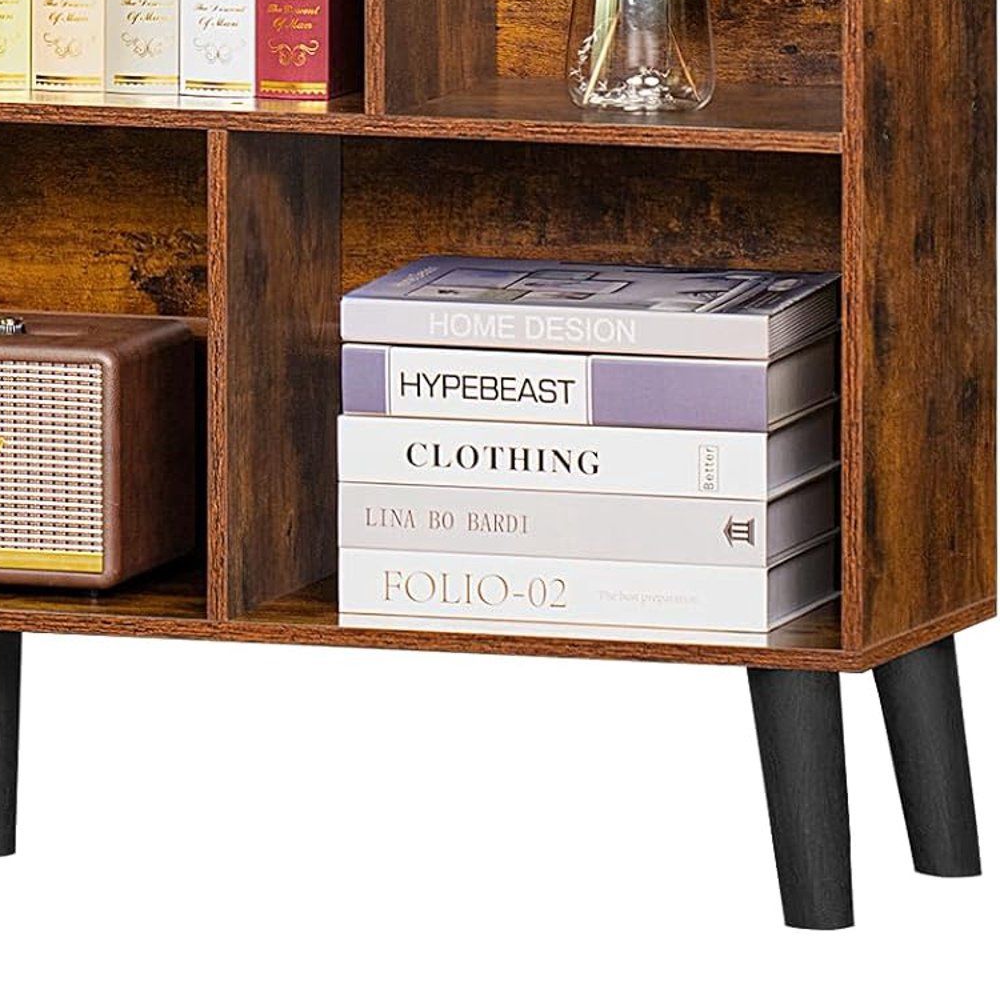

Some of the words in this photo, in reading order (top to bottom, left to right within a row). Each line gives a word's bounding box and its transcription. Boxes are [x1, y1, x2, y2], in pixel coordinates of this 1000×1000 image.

[428, 312, 515, 341] HOME
[525, 314, 638, 344] DESIGN
[400, 371, 577, 405] HYPEBEAST
[405, 442, 601, 476] CLOTHING
[365, 507, 415, 529] LINA
[428, 509, 455, 530] BO
[467, 511, 529, 534] BARDI
[382, 570, 568, 609] FOLIO-02
